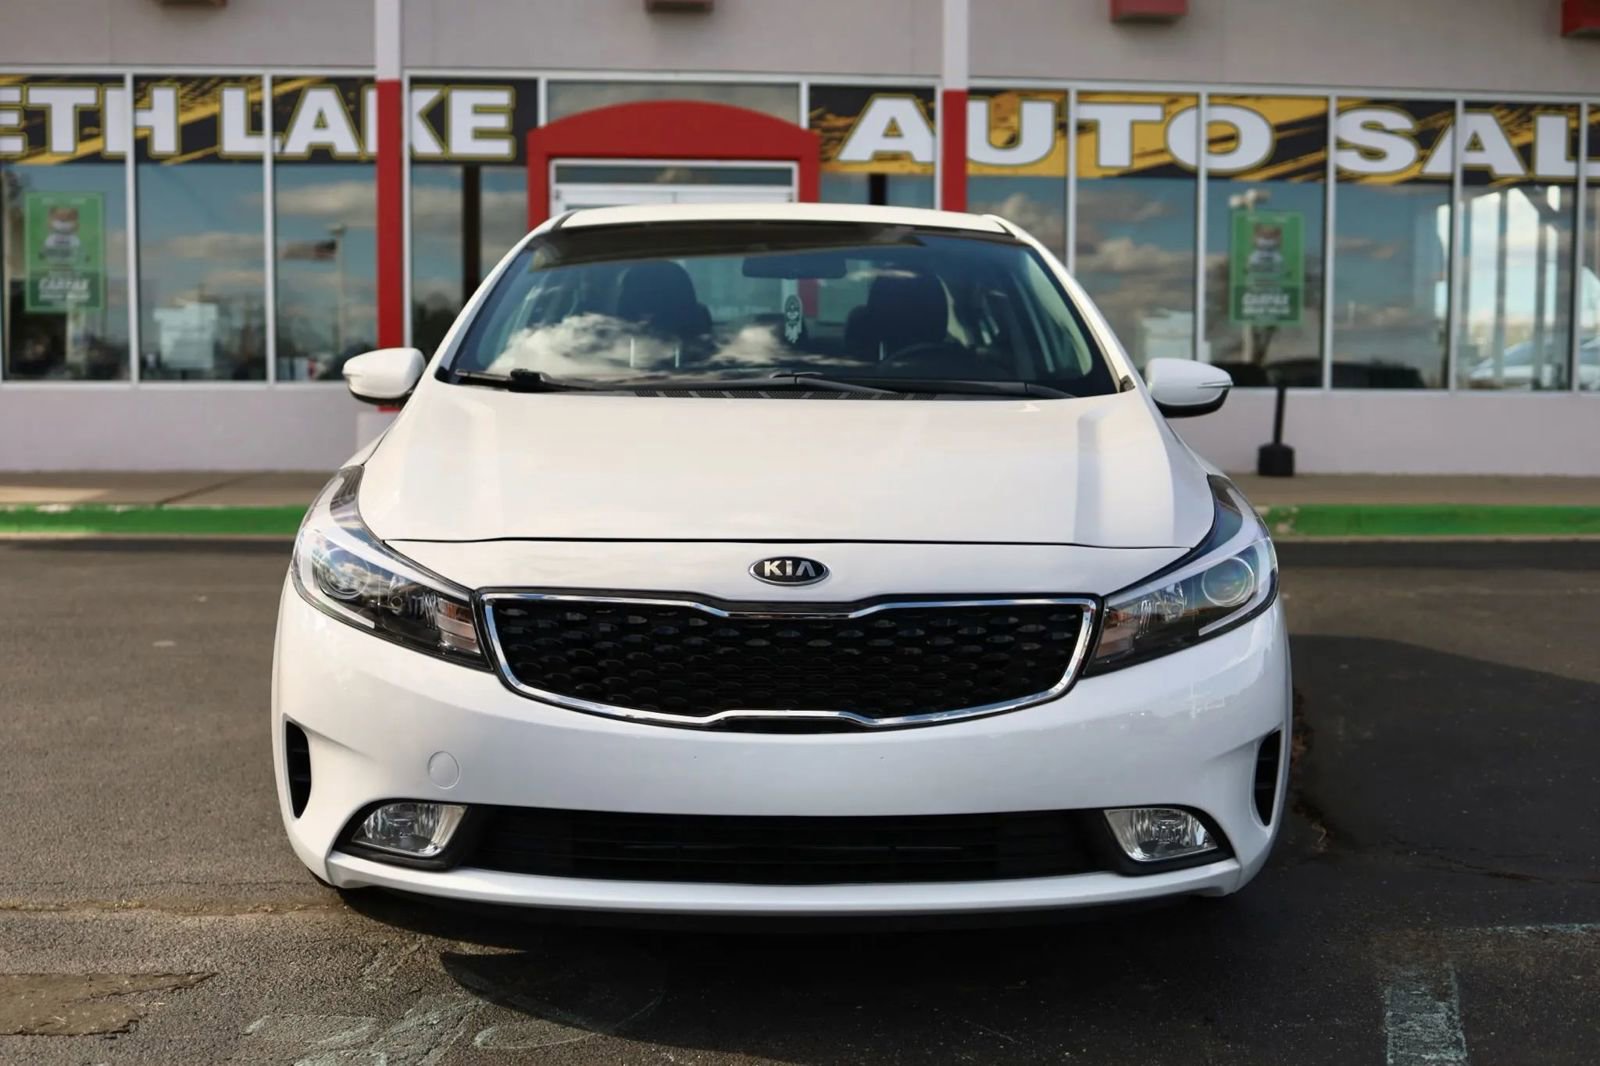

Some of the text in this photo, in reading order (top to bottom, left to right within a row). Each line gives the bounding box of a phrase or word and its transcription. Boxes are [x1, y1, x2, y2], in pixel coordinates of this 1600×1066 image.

[220, 85, 514, 158] LAKE
[838, 95, 1275, 173] AUTO
[1333, 106, 1600, 178] SAL
[764, 560, 816, 577] KIA
